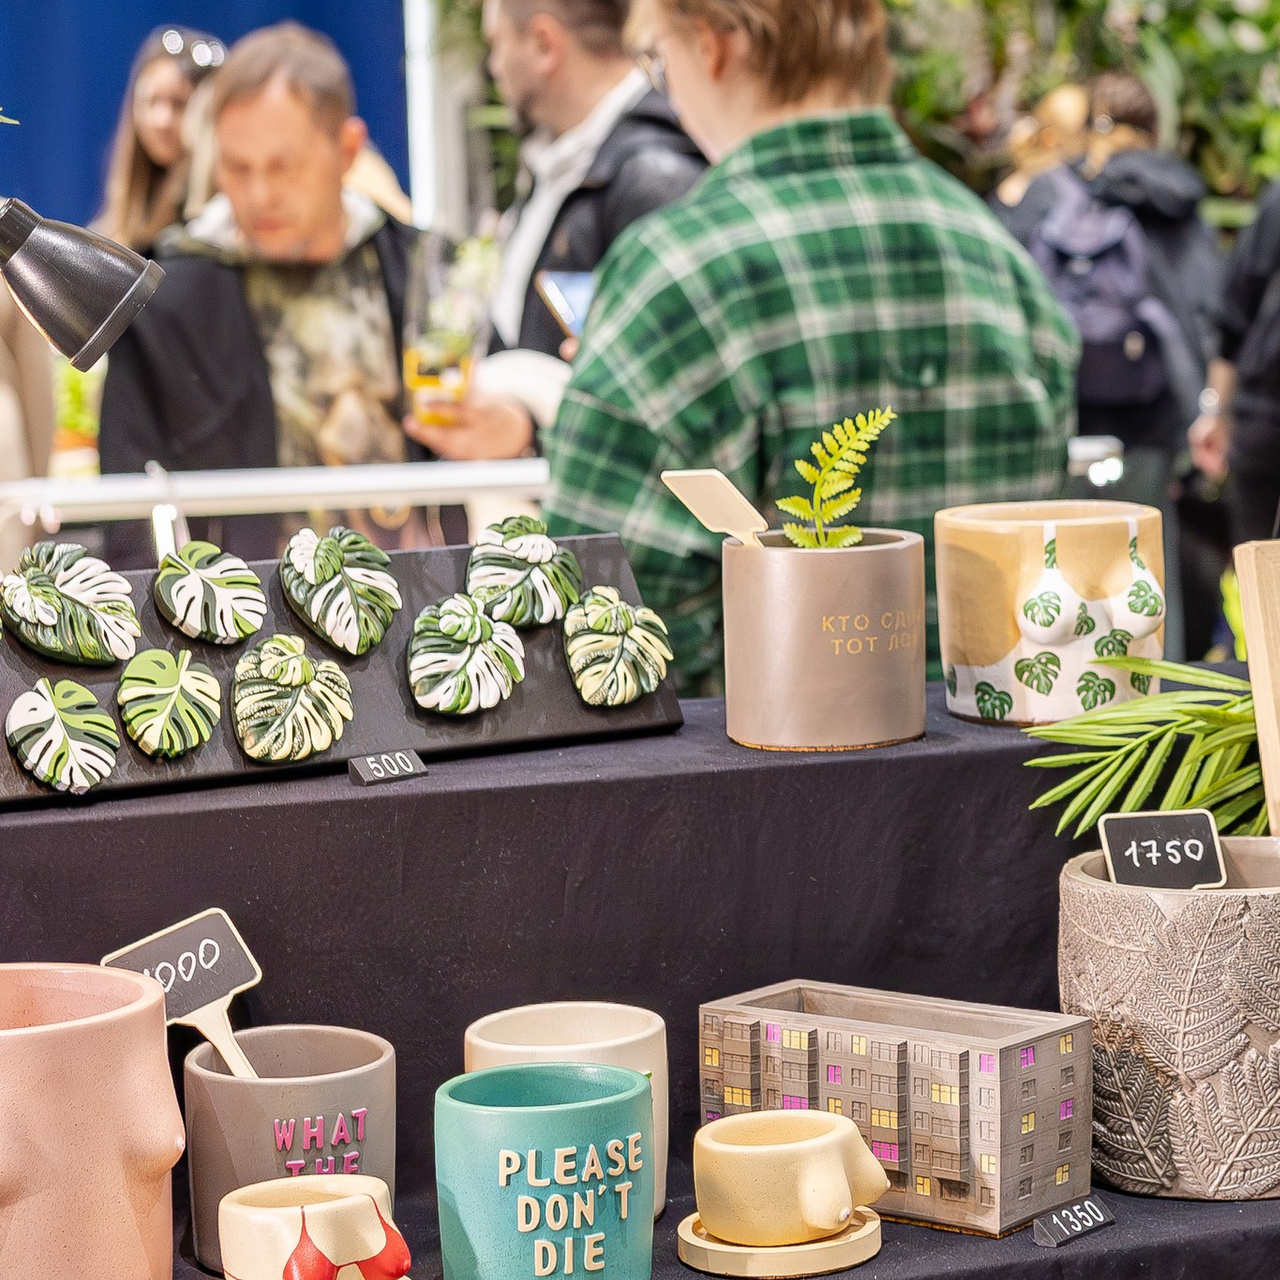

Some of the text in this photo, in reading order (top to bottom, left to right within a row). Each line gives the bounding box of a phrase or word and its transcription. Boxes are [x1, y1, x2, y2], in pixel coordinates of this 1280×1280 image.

[821, 612, 870, 633] КТО
[831, 636, 878, 656] ТОТ
[363, 750, 416, 778] 500
[1124, 838, 1205, 869] 1750
[143, 938, 221, 993] 000
[273, 1107, 369, 1152] WHAT
[498, 1131, 645, 1188] PLEASE
[516, 1181, 635, 1235] DON'T
[1052, 1201, 1104, 1238] 1350
[533, 1231, 607, 1279] DIE
